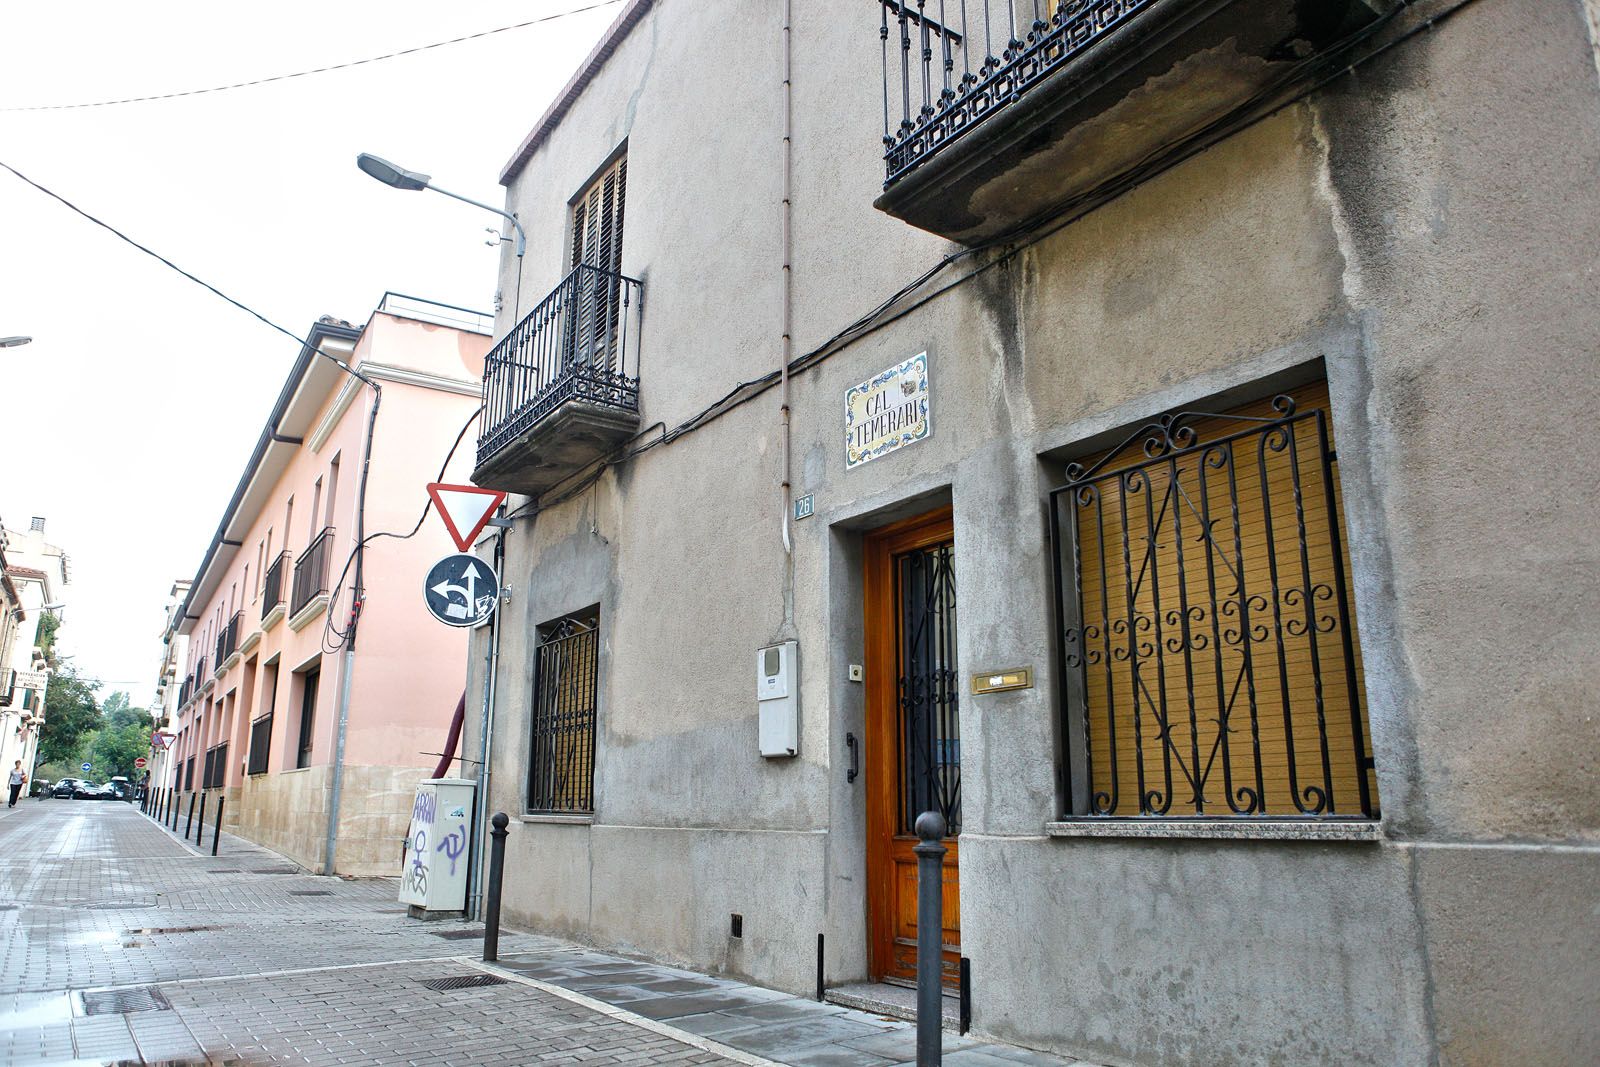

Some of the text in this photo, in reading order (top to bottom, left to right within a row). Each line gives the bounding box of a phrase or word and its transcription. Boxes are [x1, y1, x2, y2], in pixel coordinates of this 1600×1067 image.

[866, 391, 891, 417] CAL
[855, 400, 917, 447] TEMERARI
[798, 497, 810, 516] 26
